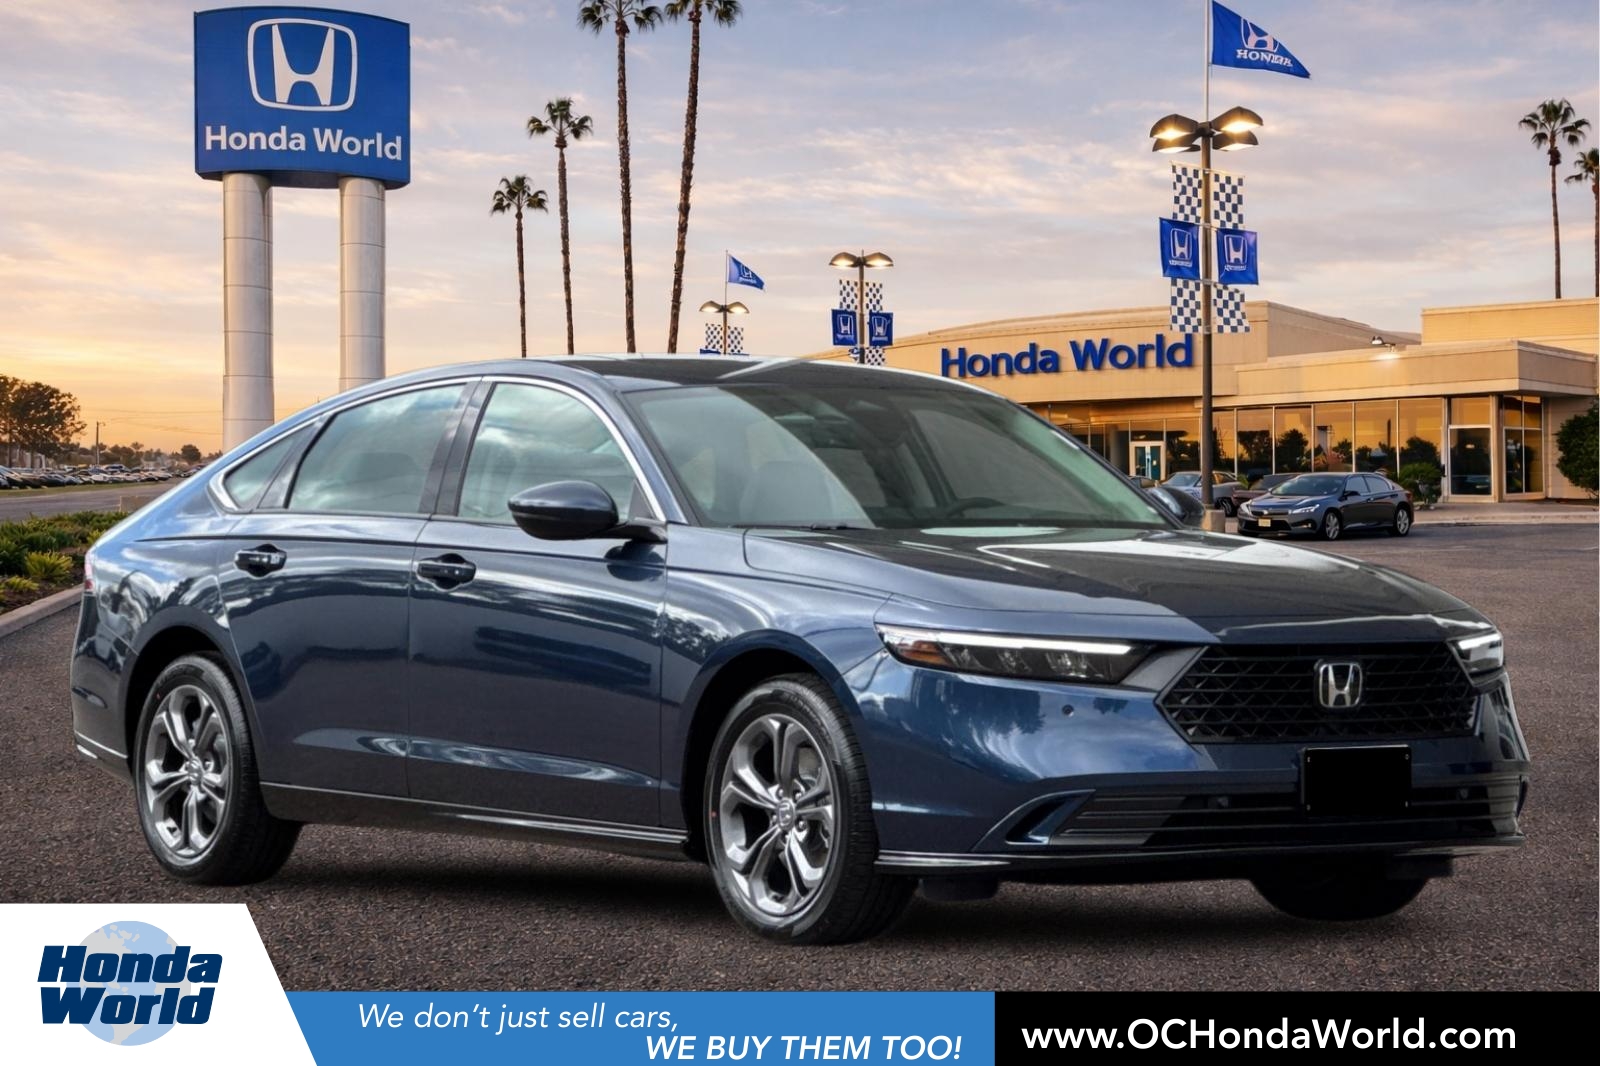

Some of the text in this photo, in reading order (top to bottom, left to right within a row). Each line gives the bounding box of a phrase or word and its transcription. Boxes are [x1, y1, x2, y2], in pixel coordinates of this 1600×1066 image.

[205, 125, 402, 161] Honda World
[941, 333, 1194, 378] Honda World
